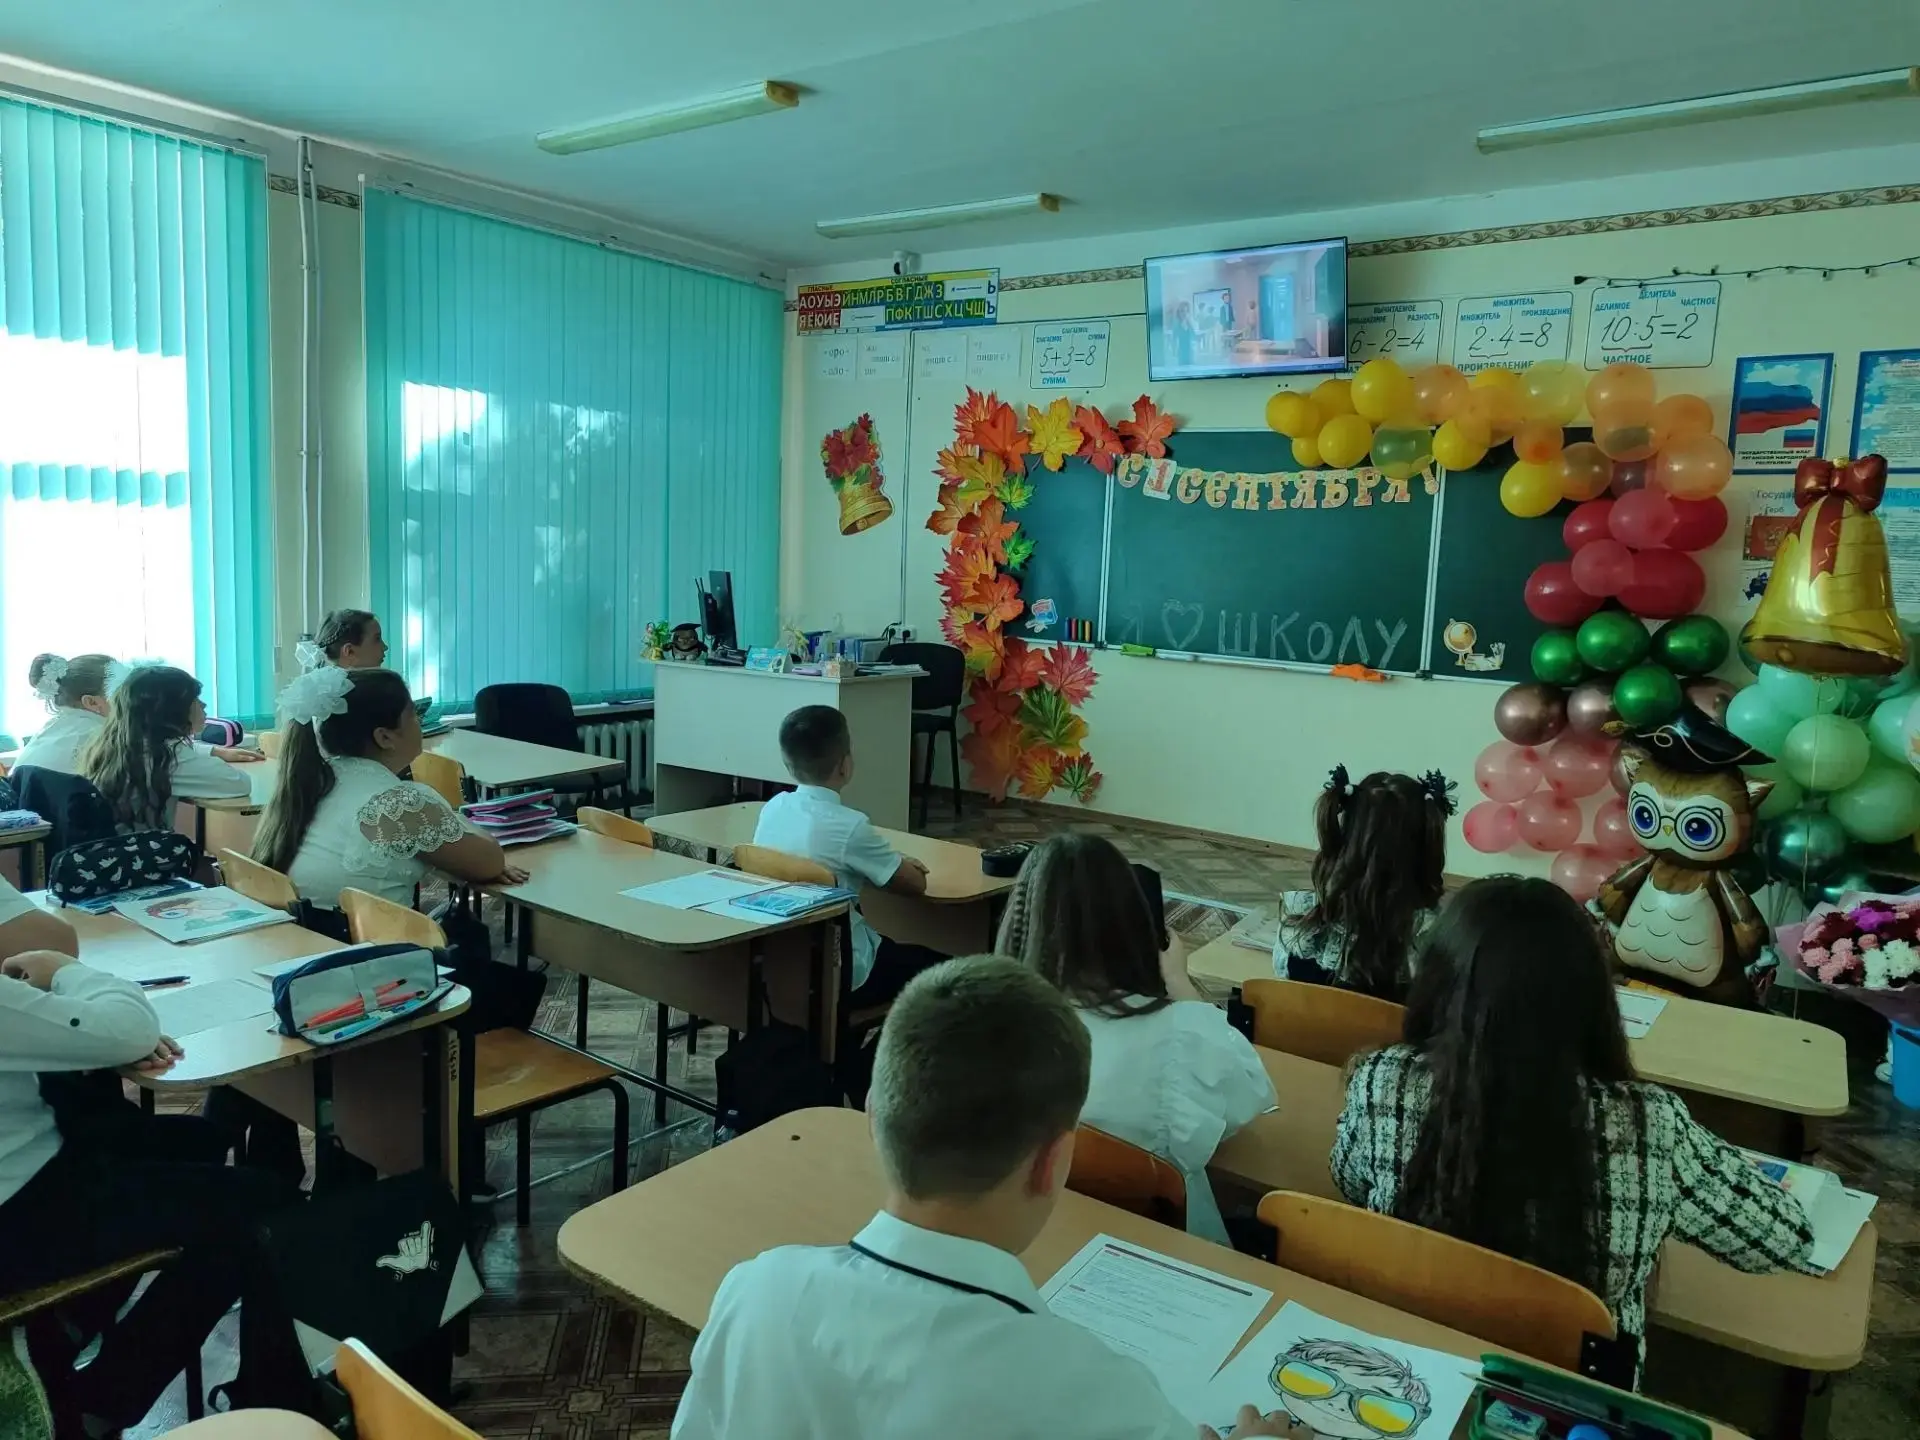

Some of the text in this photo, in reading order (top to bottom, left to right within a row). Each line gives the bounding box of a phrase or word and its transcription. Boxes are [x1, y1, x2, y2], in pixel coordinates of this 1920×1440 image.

[1638, 288, 1677, 300] ДЕЛИТЕЛЬ
[1492, 297, 1535, 308] МНОЖИТЕЛЬ
[1594, 301, 1631, 312] ДЕЛИМОЕ
[1680, 296, 1717, 307] ЧАСТНОЕ
[1407, 312, 1440, 321] РАЗНОСТЬ
[1460, 312, 1501, 321] МНОЖИТЕЛЬ
[1521, 308, 1572, 317] ПРОИЗВЕДЕНИЕ
[1602, 354, 1652, 365] ЧАСТНОЕ
[1041, 376, 1067, 385] СУММА
[1218, 608, 1408, 669] ШКОЛУ
